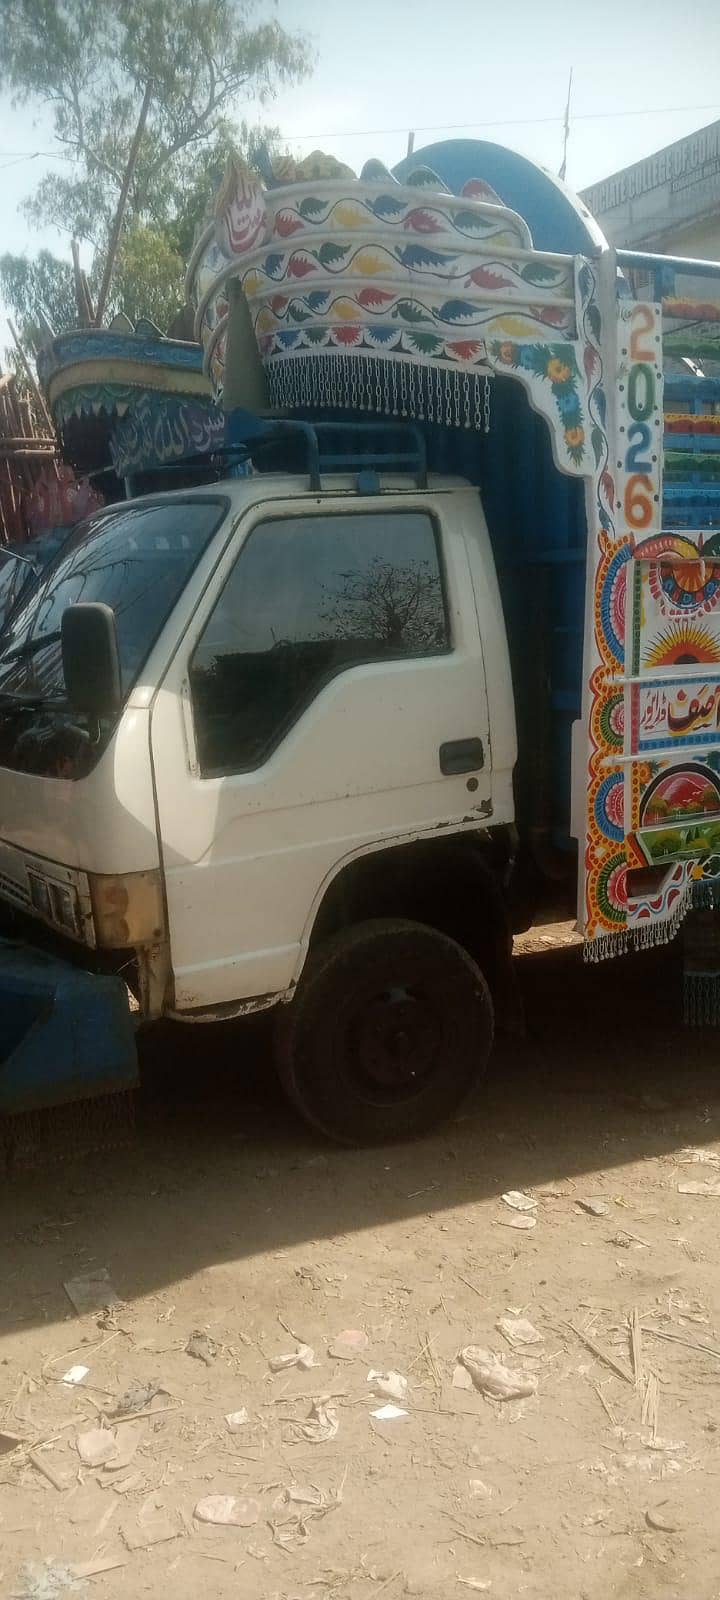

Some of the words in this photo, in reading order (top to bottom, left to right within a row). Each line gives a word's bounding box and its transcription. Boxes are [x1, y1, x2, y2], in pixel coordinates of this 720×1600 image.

[629, 153, 672, 197] COLLEGE
[673, 144, 689, 177] OF
[691, 129, 720, 166] COM
[624, 303, 656, 529] 2026
